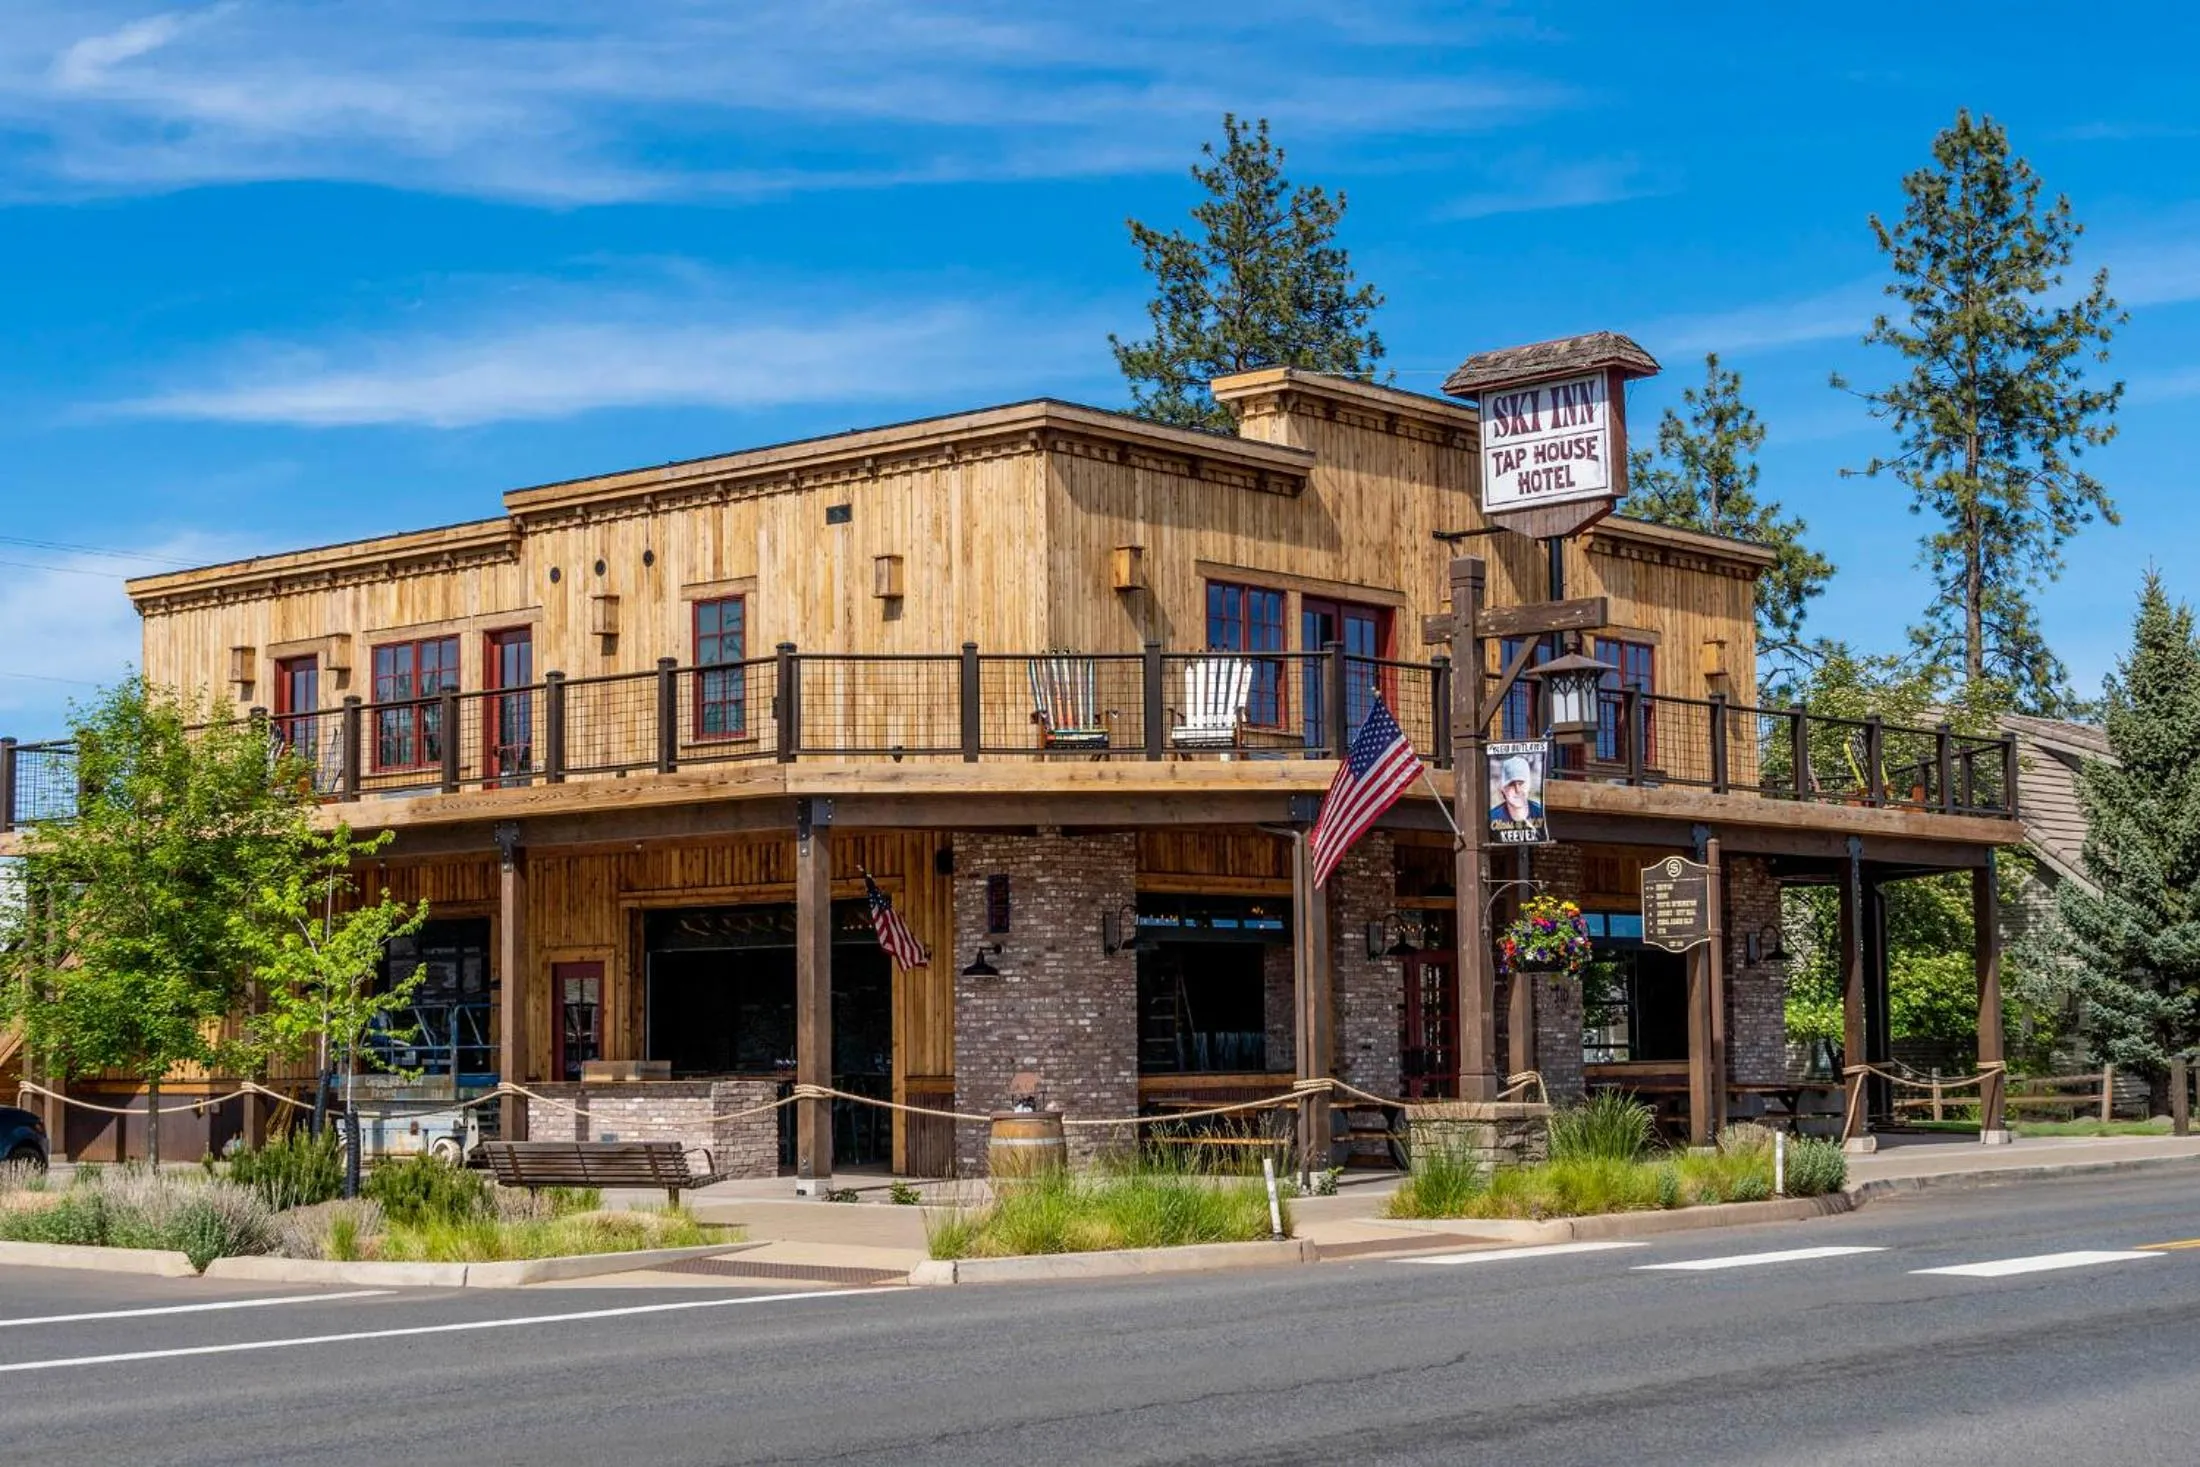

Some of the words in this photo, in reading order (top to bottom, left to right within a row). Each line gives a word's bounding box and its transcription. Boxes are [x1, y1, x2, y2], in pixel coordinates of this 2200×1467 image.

[1493, 390, 1541, 438] SKI
[1550, 380, 1595, 429] INN
[1492, 448, 1527, 478] TAP
[1534, 435, 1599, 464] HOUSE
[1518, 464, 1575, 495] HOTEL
